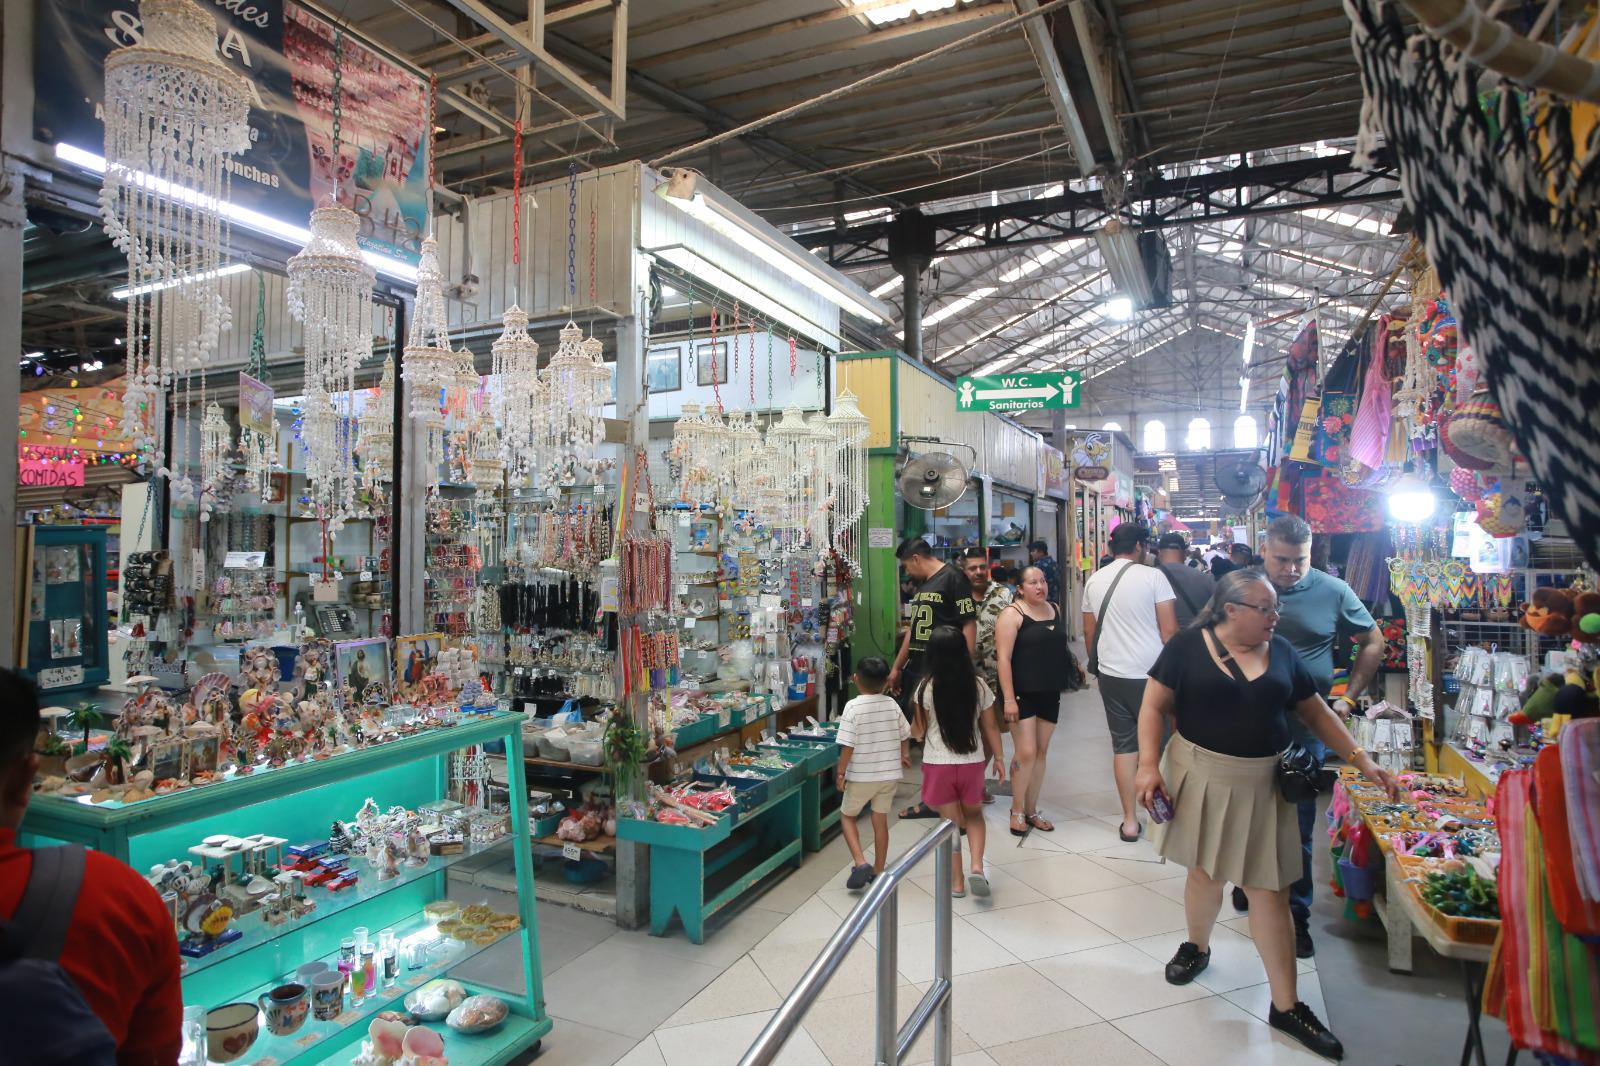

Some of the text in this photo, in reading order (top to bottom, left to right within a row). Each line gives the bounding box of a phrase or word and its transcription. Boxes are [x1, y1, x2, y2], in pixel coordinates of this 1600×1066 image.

[1001, 377, 1033, 388] W.C.
[989, 400, 1044, 410] Sanitarios
[21, 469, 78, 486] COMIDAS
[955, 597, 975, 615] 72
